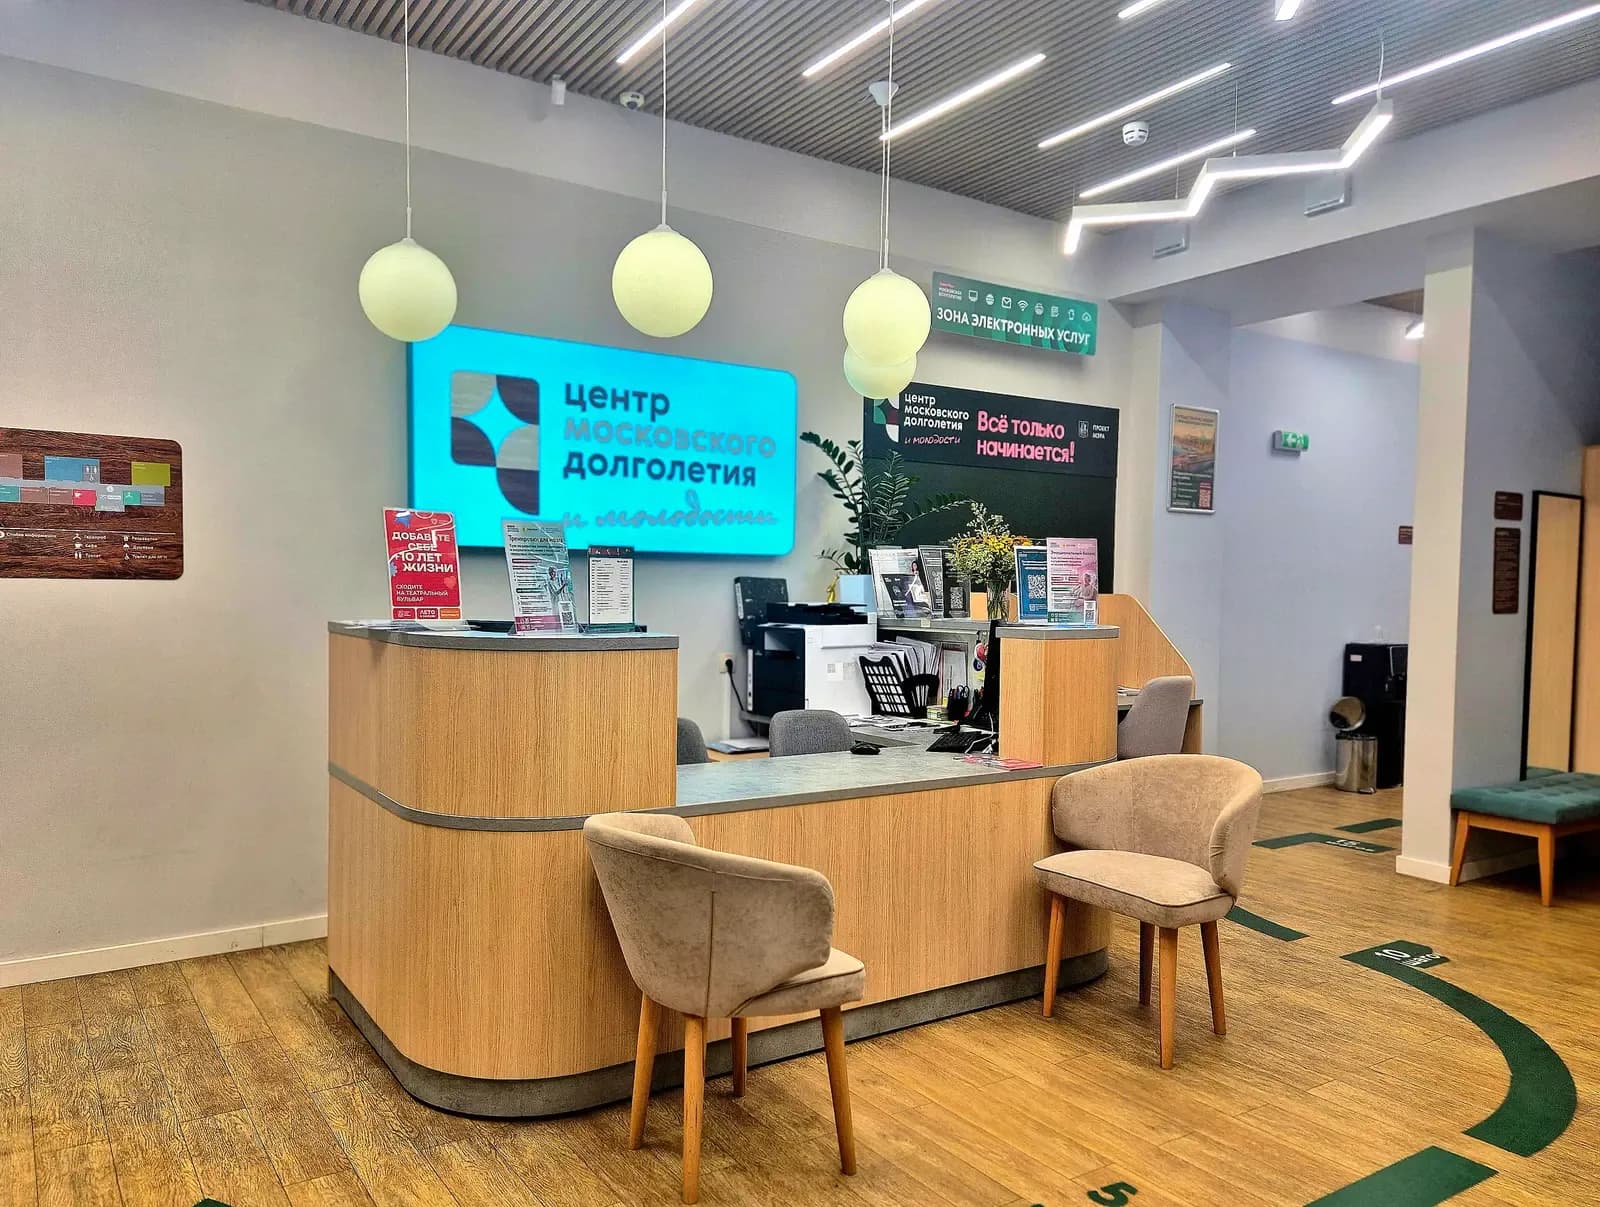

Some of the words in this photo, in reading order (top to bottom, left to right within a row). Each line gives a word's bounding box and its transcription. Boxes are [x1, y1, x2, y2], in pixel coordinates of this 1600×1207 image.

[936, 307, 969, 325] ЗОНА
[971, 313, 1055, 340] ЭЛЕКТРОННЫХ
[1057, 328, 1090, 346] УСЛУГ
[564, 381, 671, 421] центр
[904, 393, 936, 406] центр
[904, 405, 970, 420] московского
[904, 415, 963, 431] долголетия
[976, 410, 1009, 433] Всё
[1011, 419, 1065, 439] только
[564, 418, 777, 458] московского
[904, 437, 911, 445] и
[912, 433, 961, 445] молодости
[976, 438, 1075, 464] начинается!
[563, 450, 757, 488] долголетия
[562, 511, 588, 528] и
[595, 488, 779, 527] молодости
[408, 542, 438, 551] СЕБЕ
[417, 553, 442, 562] ЛЕТ
[403, 563, 454, 573] ЖИЗНИ
[1087, 1181, 1138, 1207] 5
